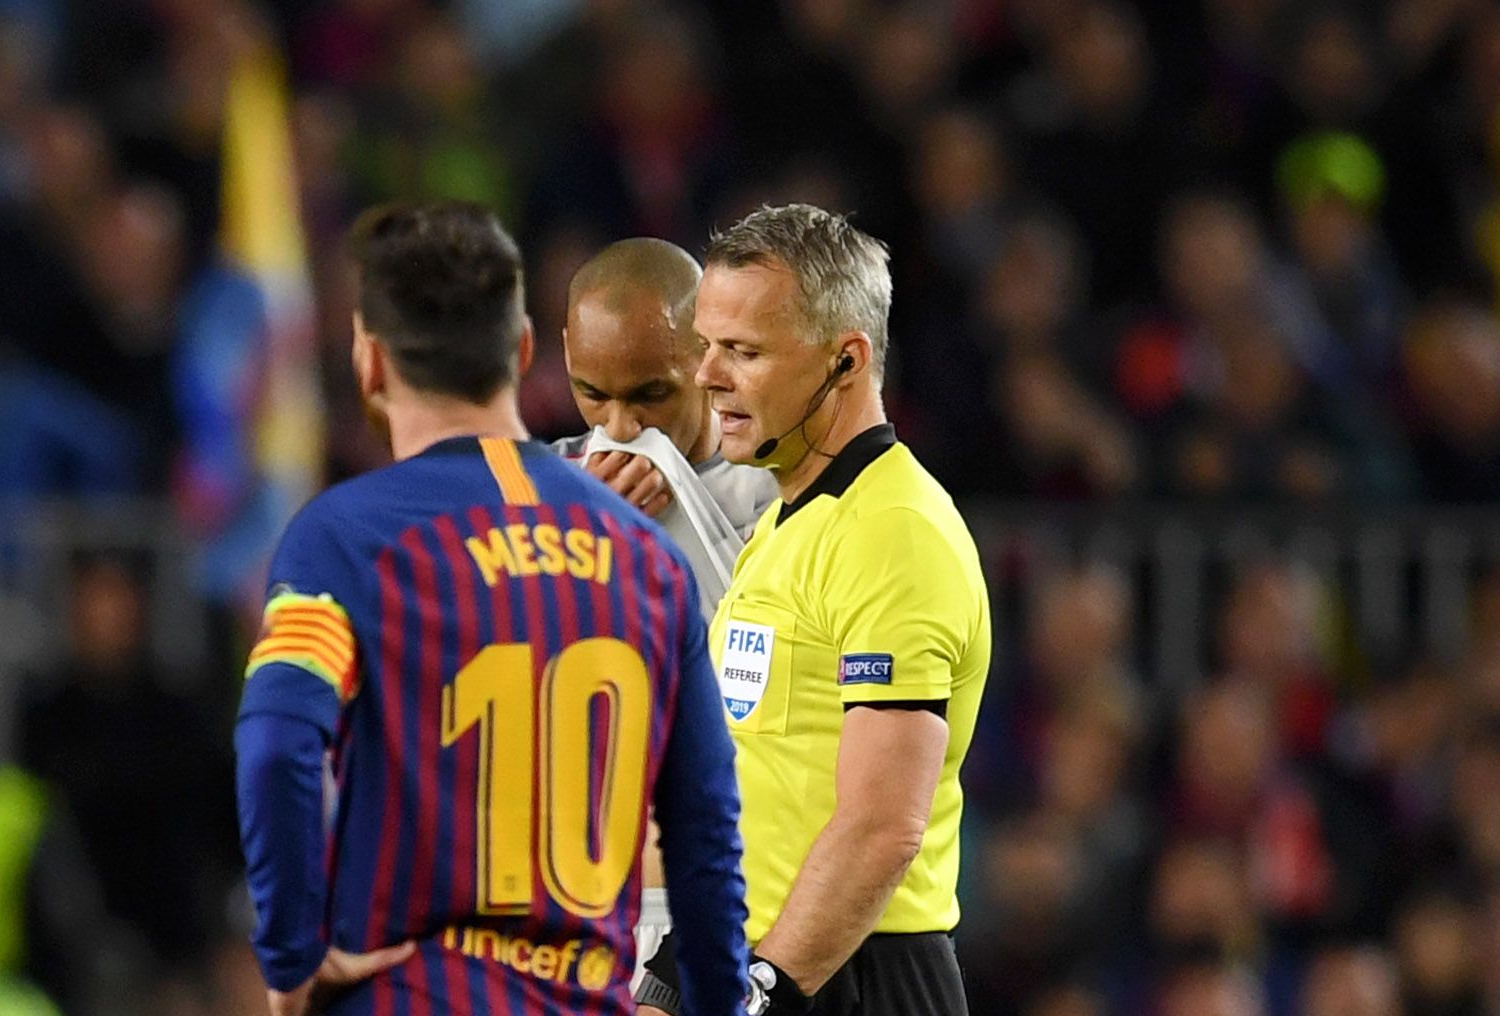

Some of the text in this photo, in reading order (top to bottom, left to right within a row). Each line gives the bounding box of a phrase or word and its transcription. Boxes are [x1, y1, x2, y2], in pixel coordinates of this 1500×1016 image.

[465, 523, 612, 587] MESSI
[728, 629, 766, 655] FIFA
[724, 667, 763, 684] REFEREE
[730, 700, 750, 713] 2019
[441, 636, 651, 918] 10
